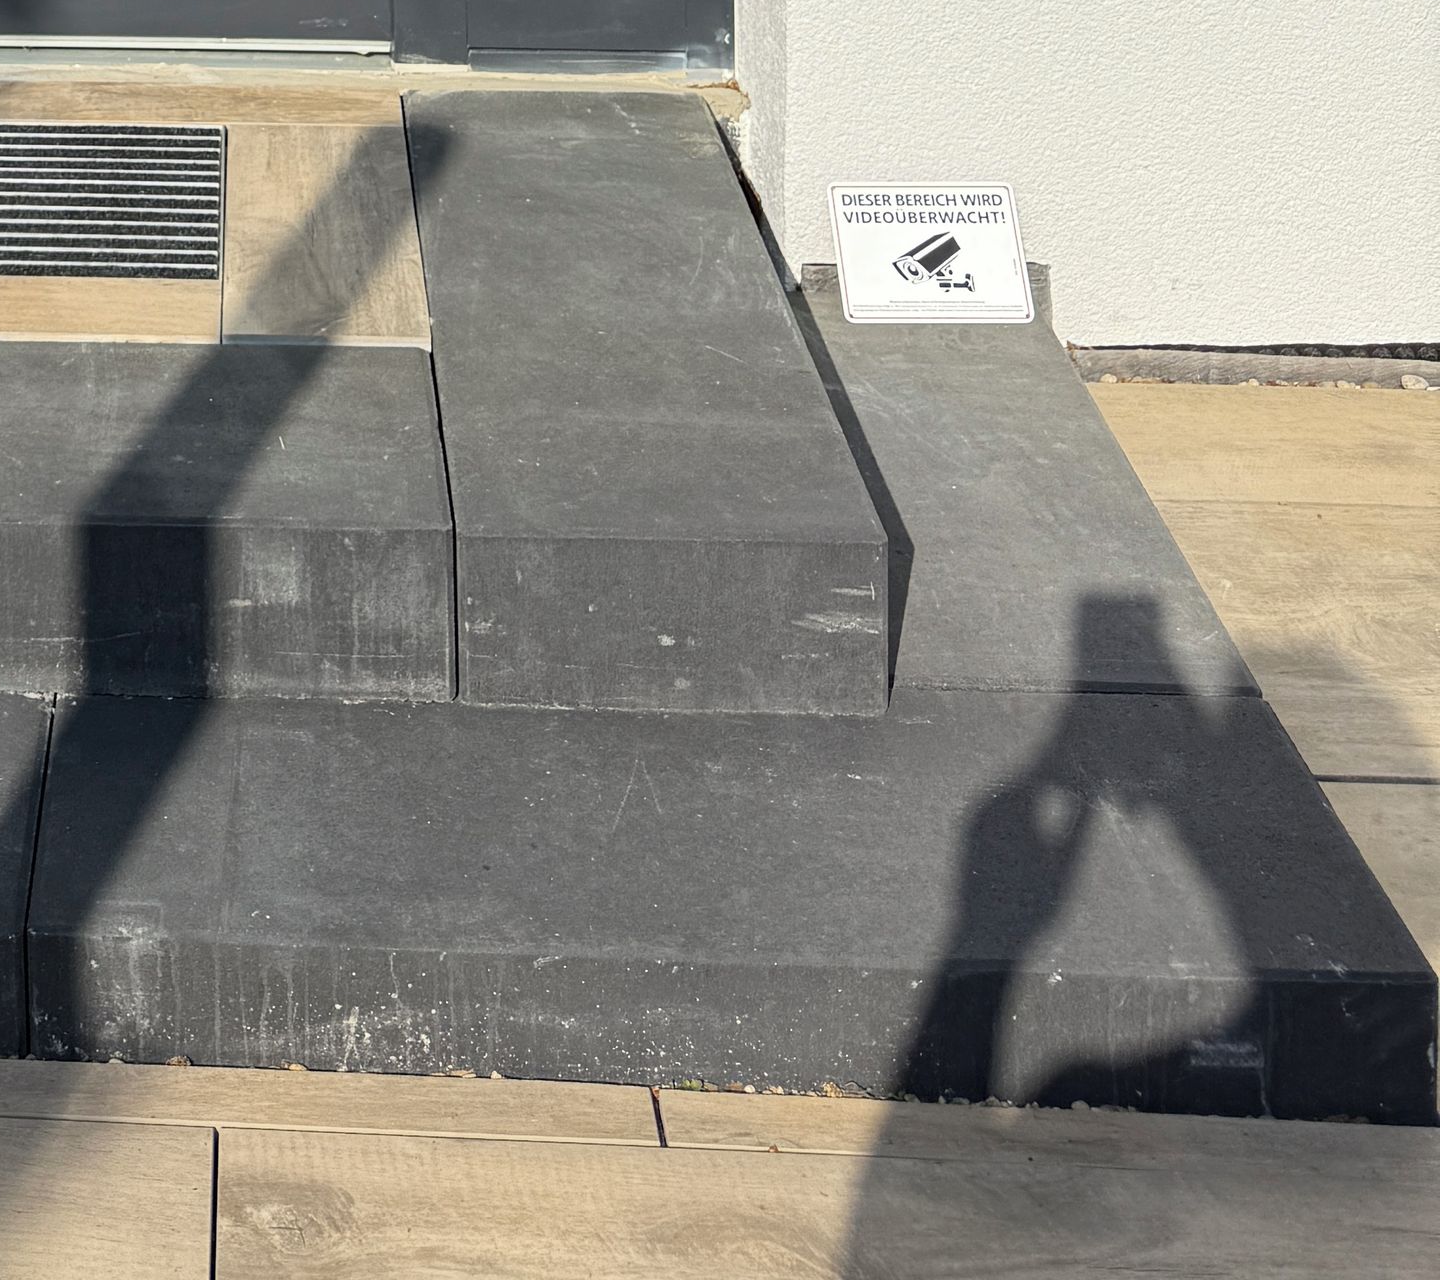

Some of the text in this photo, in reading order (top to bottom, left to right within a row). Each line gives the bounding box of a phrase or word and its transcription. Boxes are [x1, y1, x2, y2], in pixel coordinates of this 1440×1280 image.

[842, 194, 1003, 206] DIESER BEREICH WIRD
[843, 208, 1006, 224] VIDEOÜBERWACHT!
